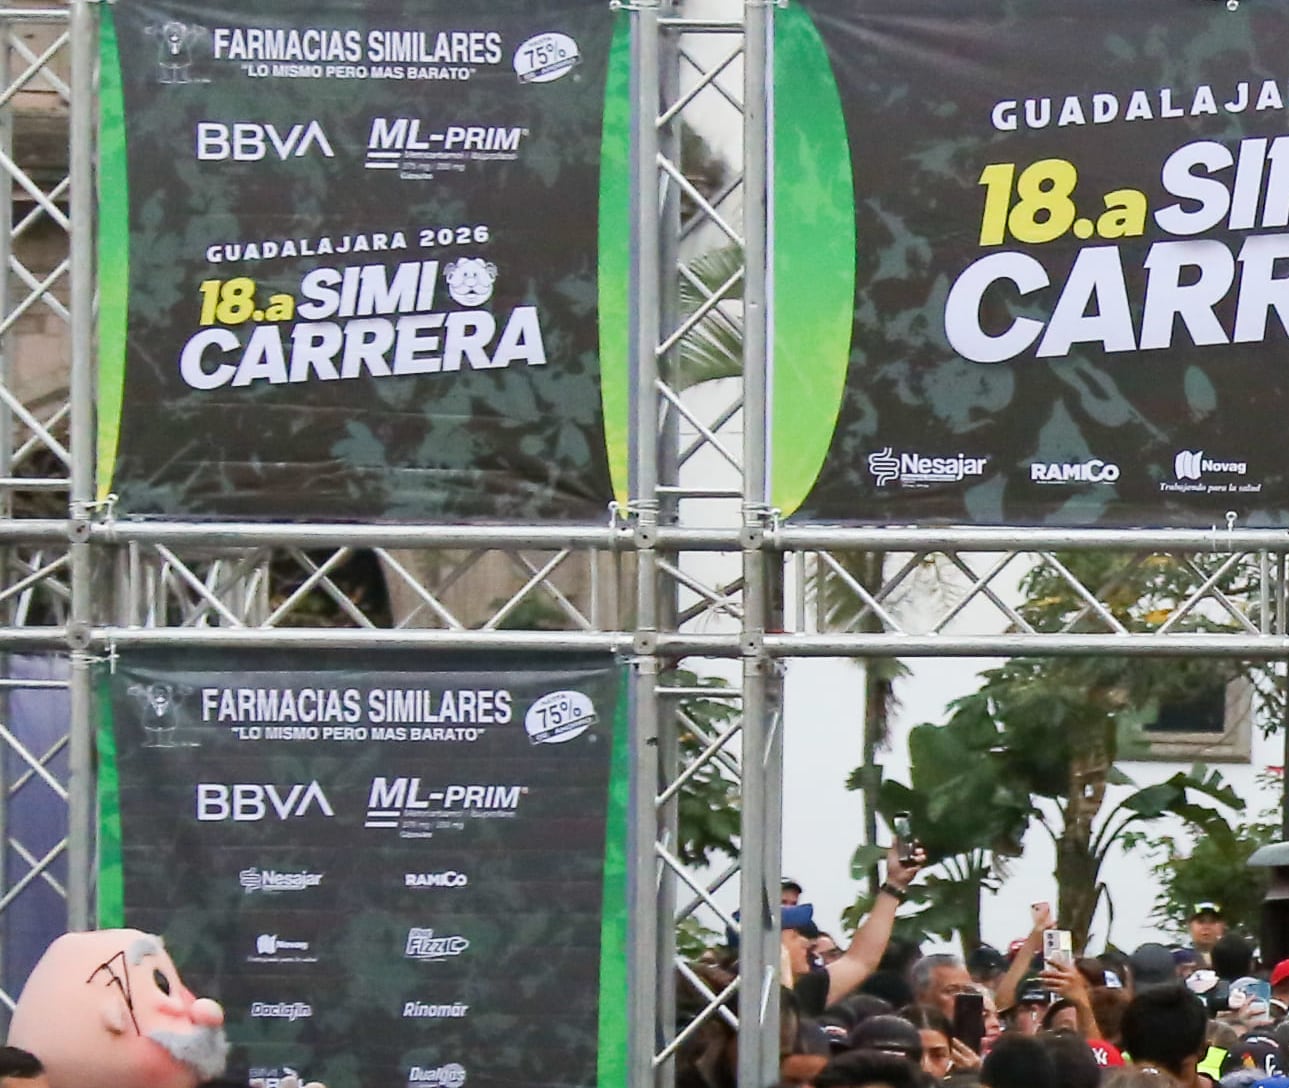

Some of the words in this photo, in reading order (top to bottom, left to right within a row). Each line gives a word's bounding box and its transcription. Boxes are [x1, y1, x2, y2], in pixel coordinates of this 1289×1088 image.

[214, 29, 361, 61] FARMACIAS
[368, 31, 501, 64] SIMILARES
[524, 40, 566, 68] 75%
[241, 64, 268, 78] "LO
[273, 65, 322, 78] MISMO
[326, 65, 367, 79] PERO
[371, 66, 407, 79] MAS
[408, 67, 476, 81] BARATO"
[198, 121, 334, 160] BBVA
[976, 158, 1148, 247] 18.a
[207, 231, 408, 263] GUADALAJARA
[420, 225, 489, 247] 2026
[198, 277, 295, 326] 18.a
[297, 260, 437, 320] SIMI
[179, 306, 547, 390] CARRERA
[902, 453, 987, 480] Nesajar
[1202, 459, 1246, 475] Novag
[202, 689, 361, 722] FARMACIAS
[368, 690, 512, 724] SIMILARES
[535, 698, 582, 728] 75%
[231, 727, 262, 740] "LO
[265, 727, 318, 741] MISMO
[322, 728, 367, 741] PERO
[371, 728, 407, 741] MAS
[410, 728, 485, 742] BARATO"
[197, 780, 334, 821] BBVA
[262, 871, 323, 887] Nesajar
